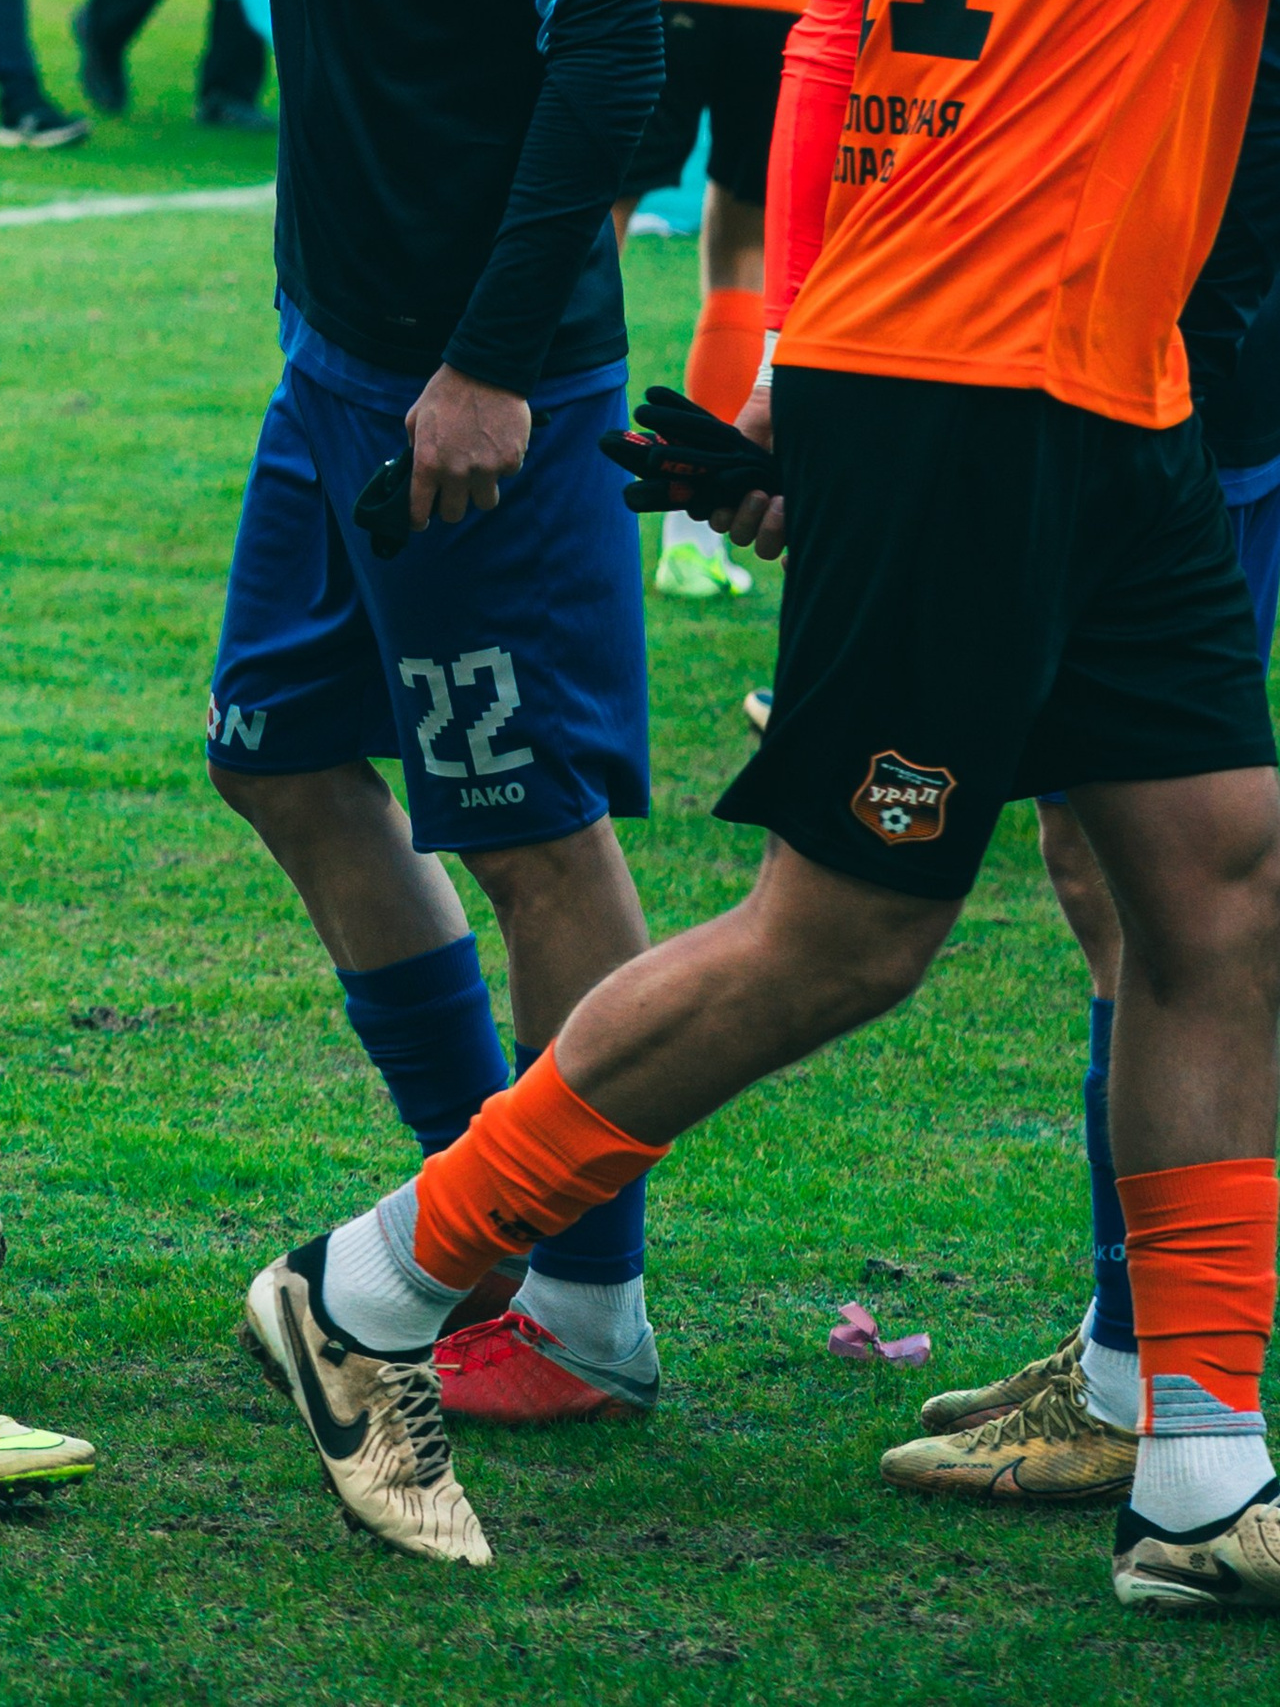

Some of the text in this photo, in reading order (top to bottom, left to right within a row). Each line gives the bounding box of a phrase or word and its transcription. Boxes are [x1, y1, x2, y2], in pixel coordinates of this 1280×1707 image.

[399, 647, 534, 778] 22
[460, 782, 526, 809] JAKO
[869, 786, 939, 805] УРАЛ
